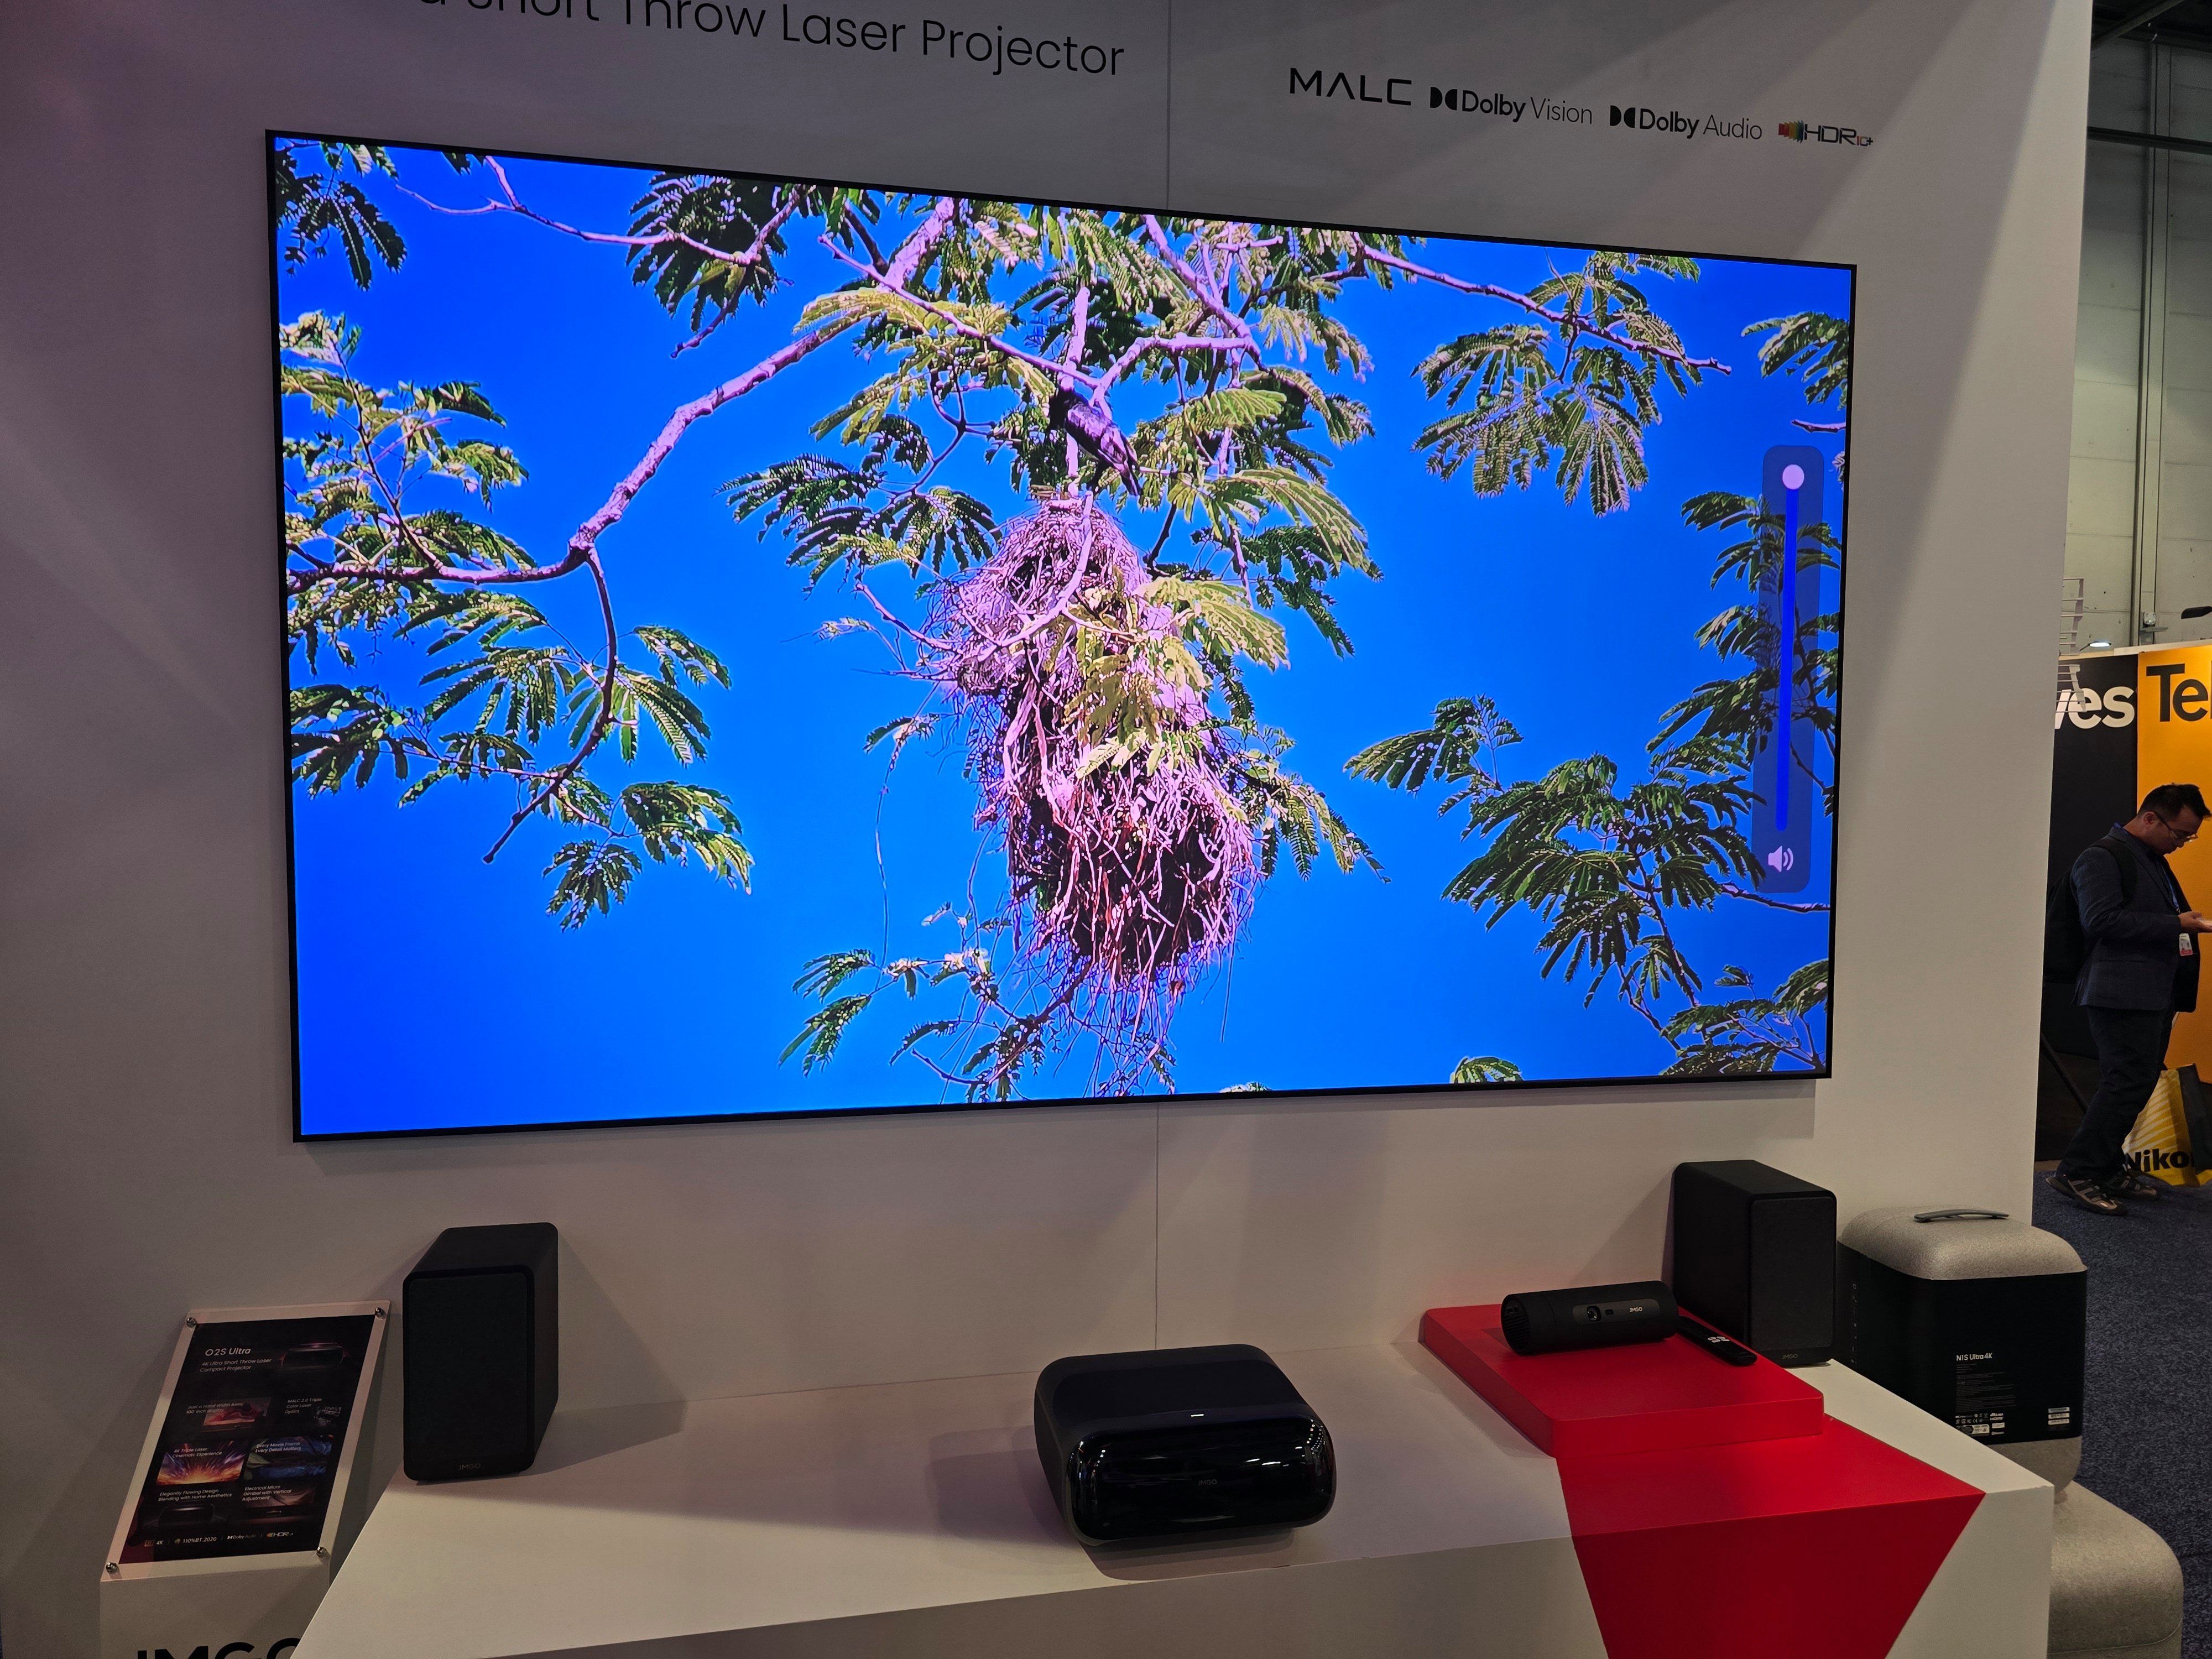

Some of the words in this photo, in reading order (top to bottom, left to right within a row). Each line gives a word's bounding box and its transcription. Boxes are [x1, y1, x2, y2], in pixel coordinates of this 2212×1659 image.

[782, 3, 906, 53] Laser
[922, 19, 1125, 76] Projector
[1289, 67, 1412, 106] MALC
[1462, 89, 1526, 123] Dolby
[1530, 96, 1593, 124] Vision
[1639, 108, 1700, 139] Dolby
[1703, 114, 1762, 140] Audio
[2146, 663, 2212, 722] Te
[2125, 1148, 2195, 1172] Niko
[228, 1347, 252, 1355] Ultra
